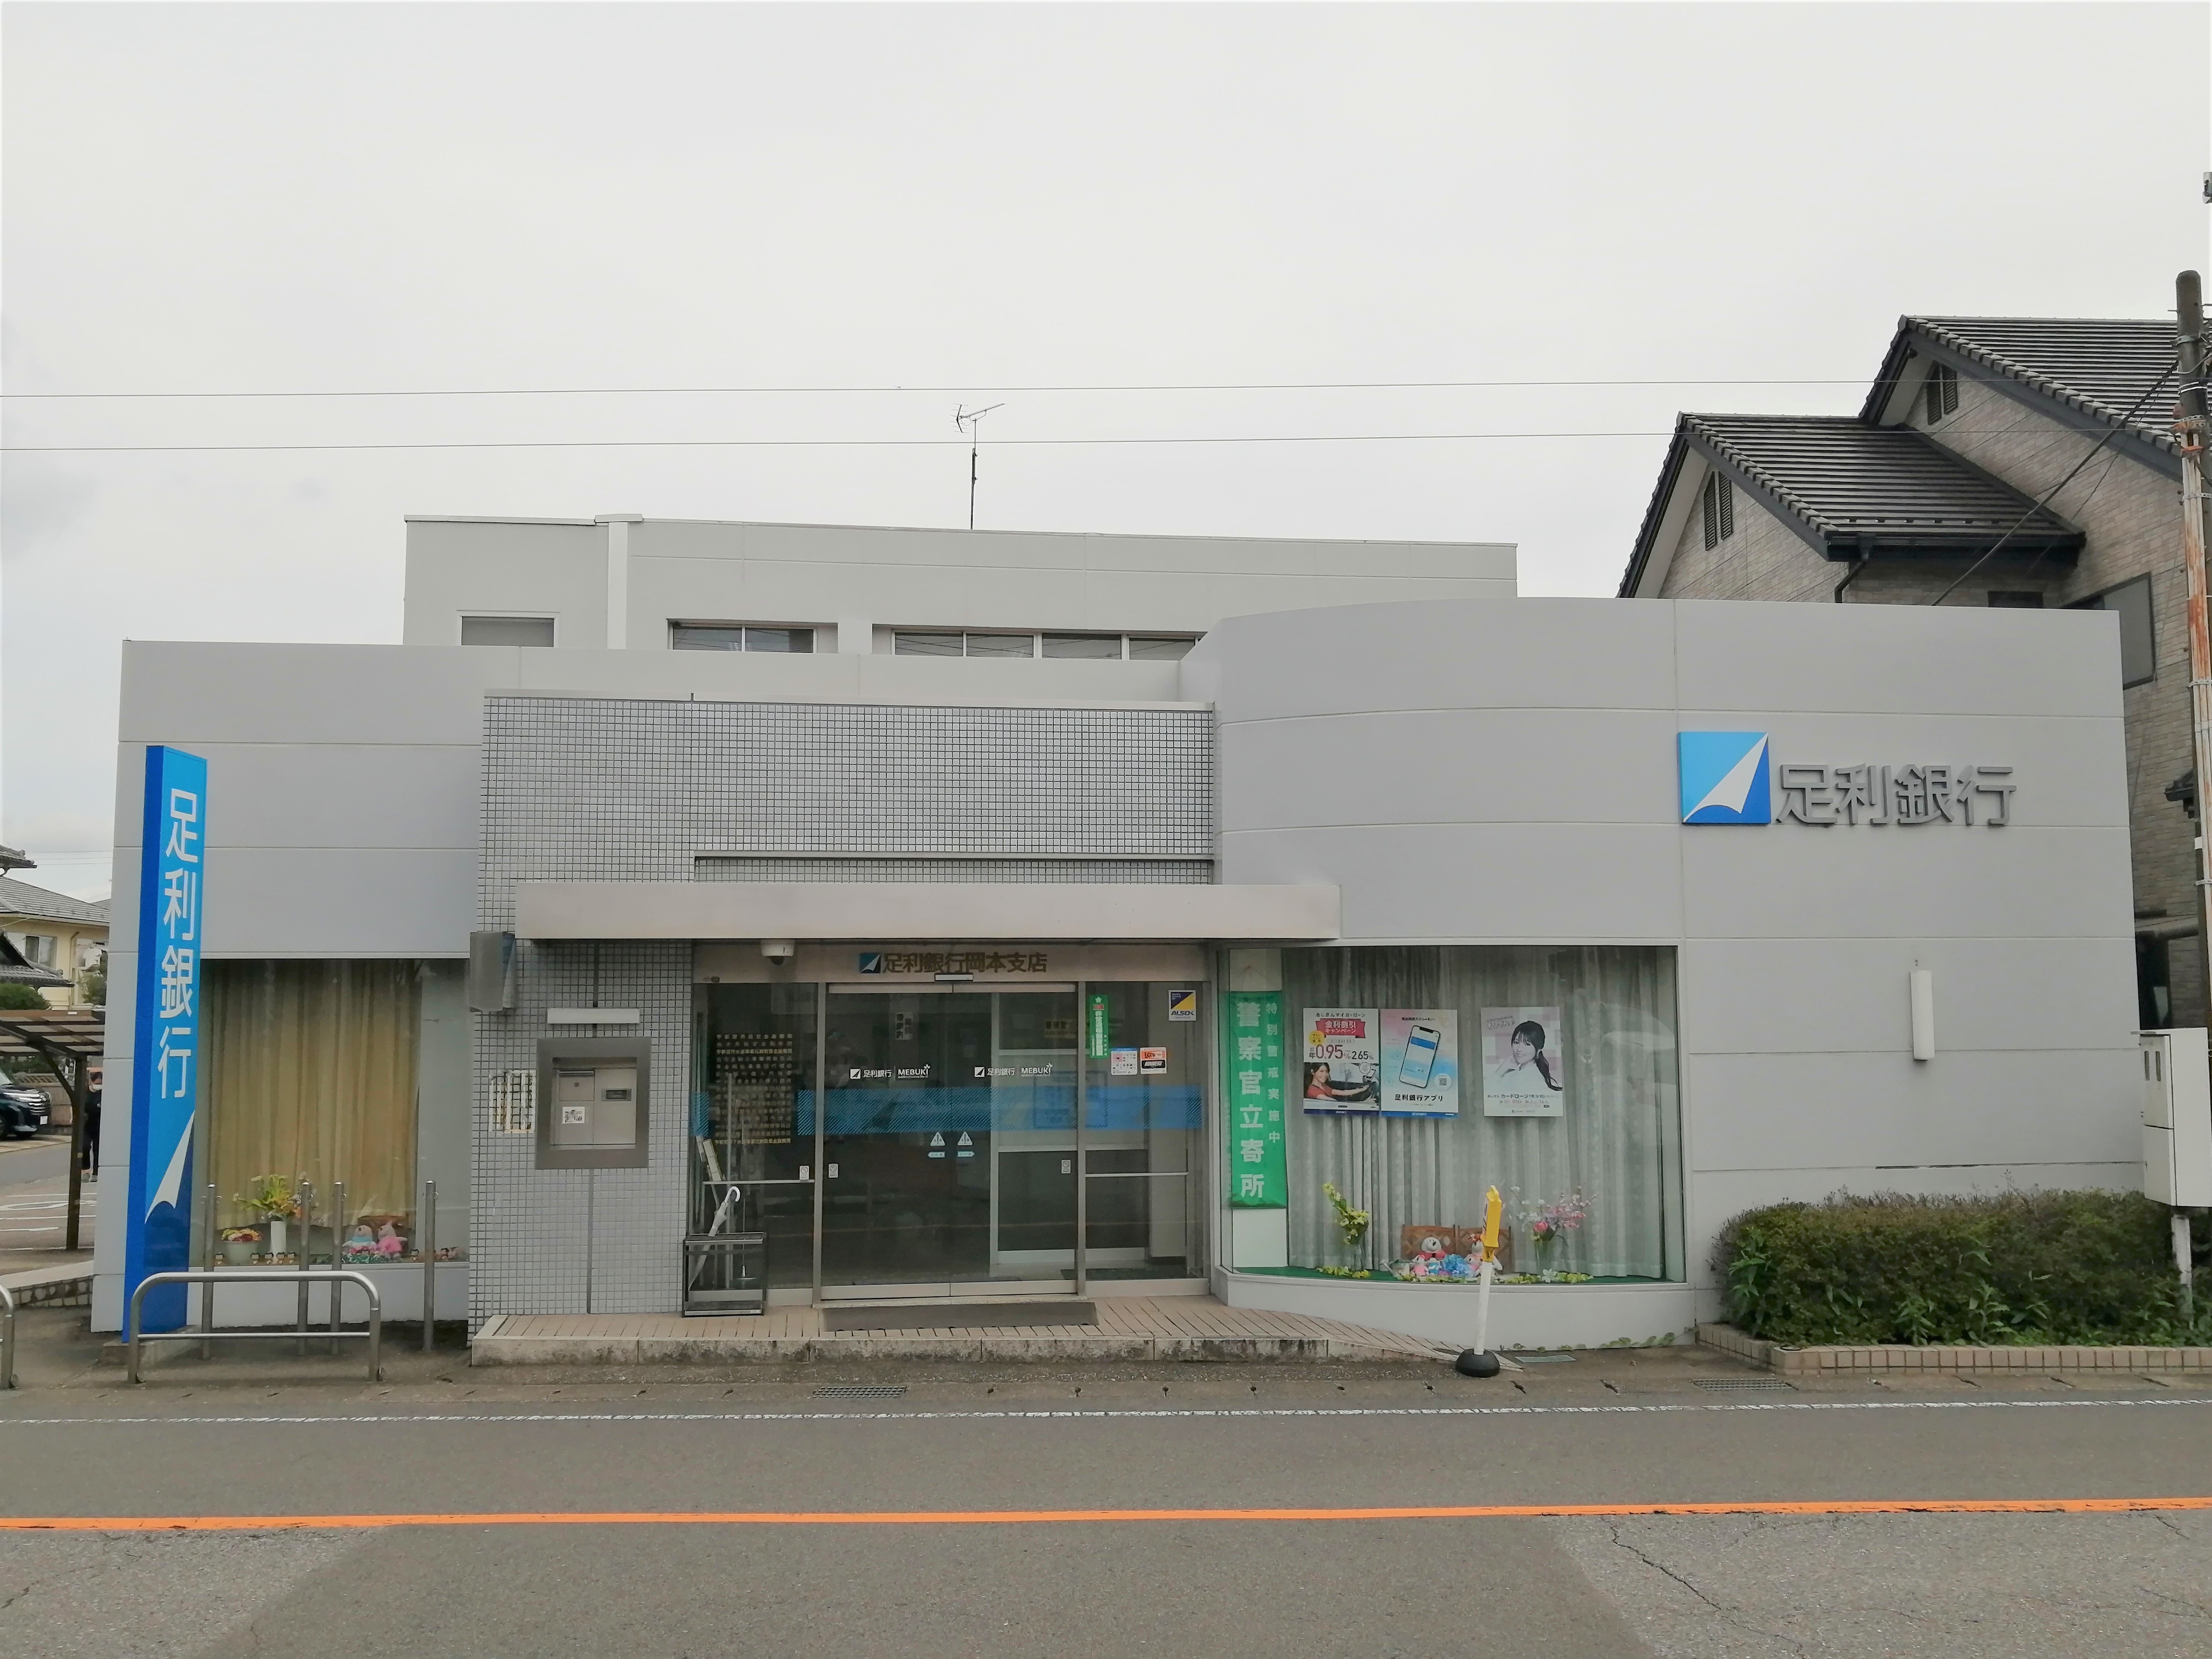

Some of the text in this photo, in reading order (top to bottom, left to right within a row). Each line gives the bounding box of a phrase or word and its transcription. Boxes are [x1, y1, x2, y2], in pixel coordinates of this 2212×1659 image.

[1775, 764, 2017, 826] 足利銀行
[157, 788, 198, 1099] 足利銀行
[883, 951, 1048, 974] 足利銀行岡本支店
[898, 1065, 930, 1075] MEBUKI
[1021, 1064, 1053, 1074] MEBUKI
[1237, 1002, 1265, 1198] 警察官立寄所
[1265, 1002, 1280, 1144] 特別警戒実施中
